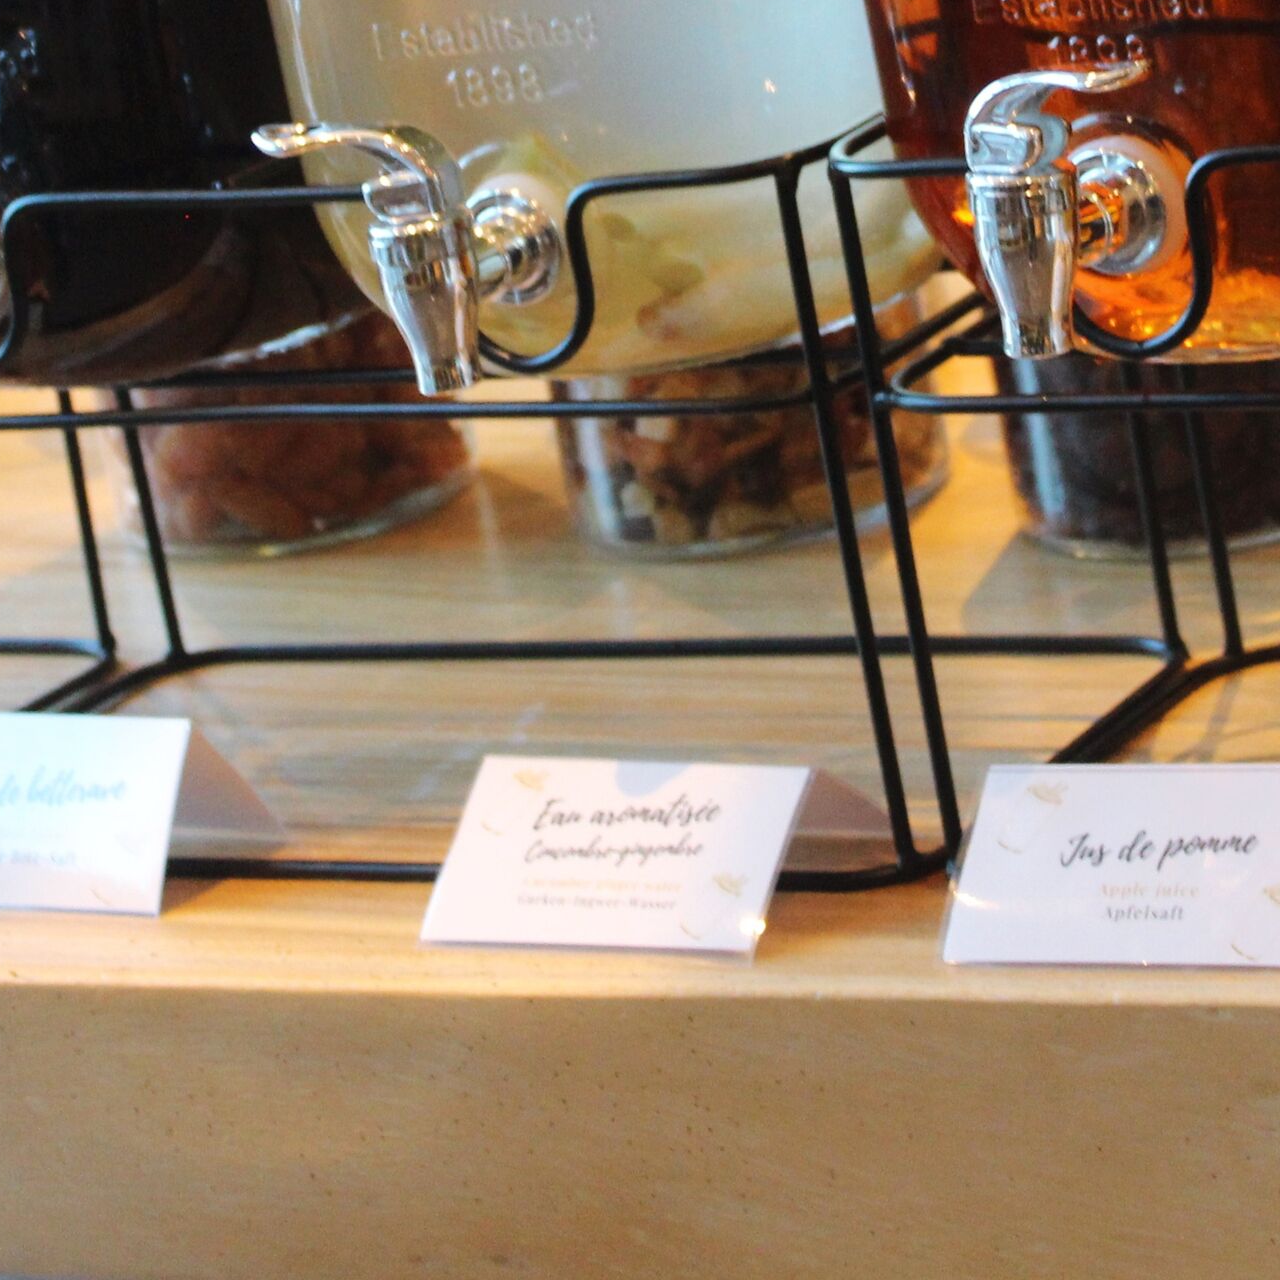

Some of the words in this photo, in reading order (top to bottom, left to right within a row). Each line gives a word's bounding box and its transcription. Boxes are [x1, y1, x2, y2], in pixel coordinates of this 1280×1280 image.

[531, 796, 582, 832] Eau
[1060, 832, 1110, 868] Jus
[1117, 830, 1156, 863] de
[1156, 833, 1258, 872] pomme
[1105, 904, 1186, 923] Apfelsaft
